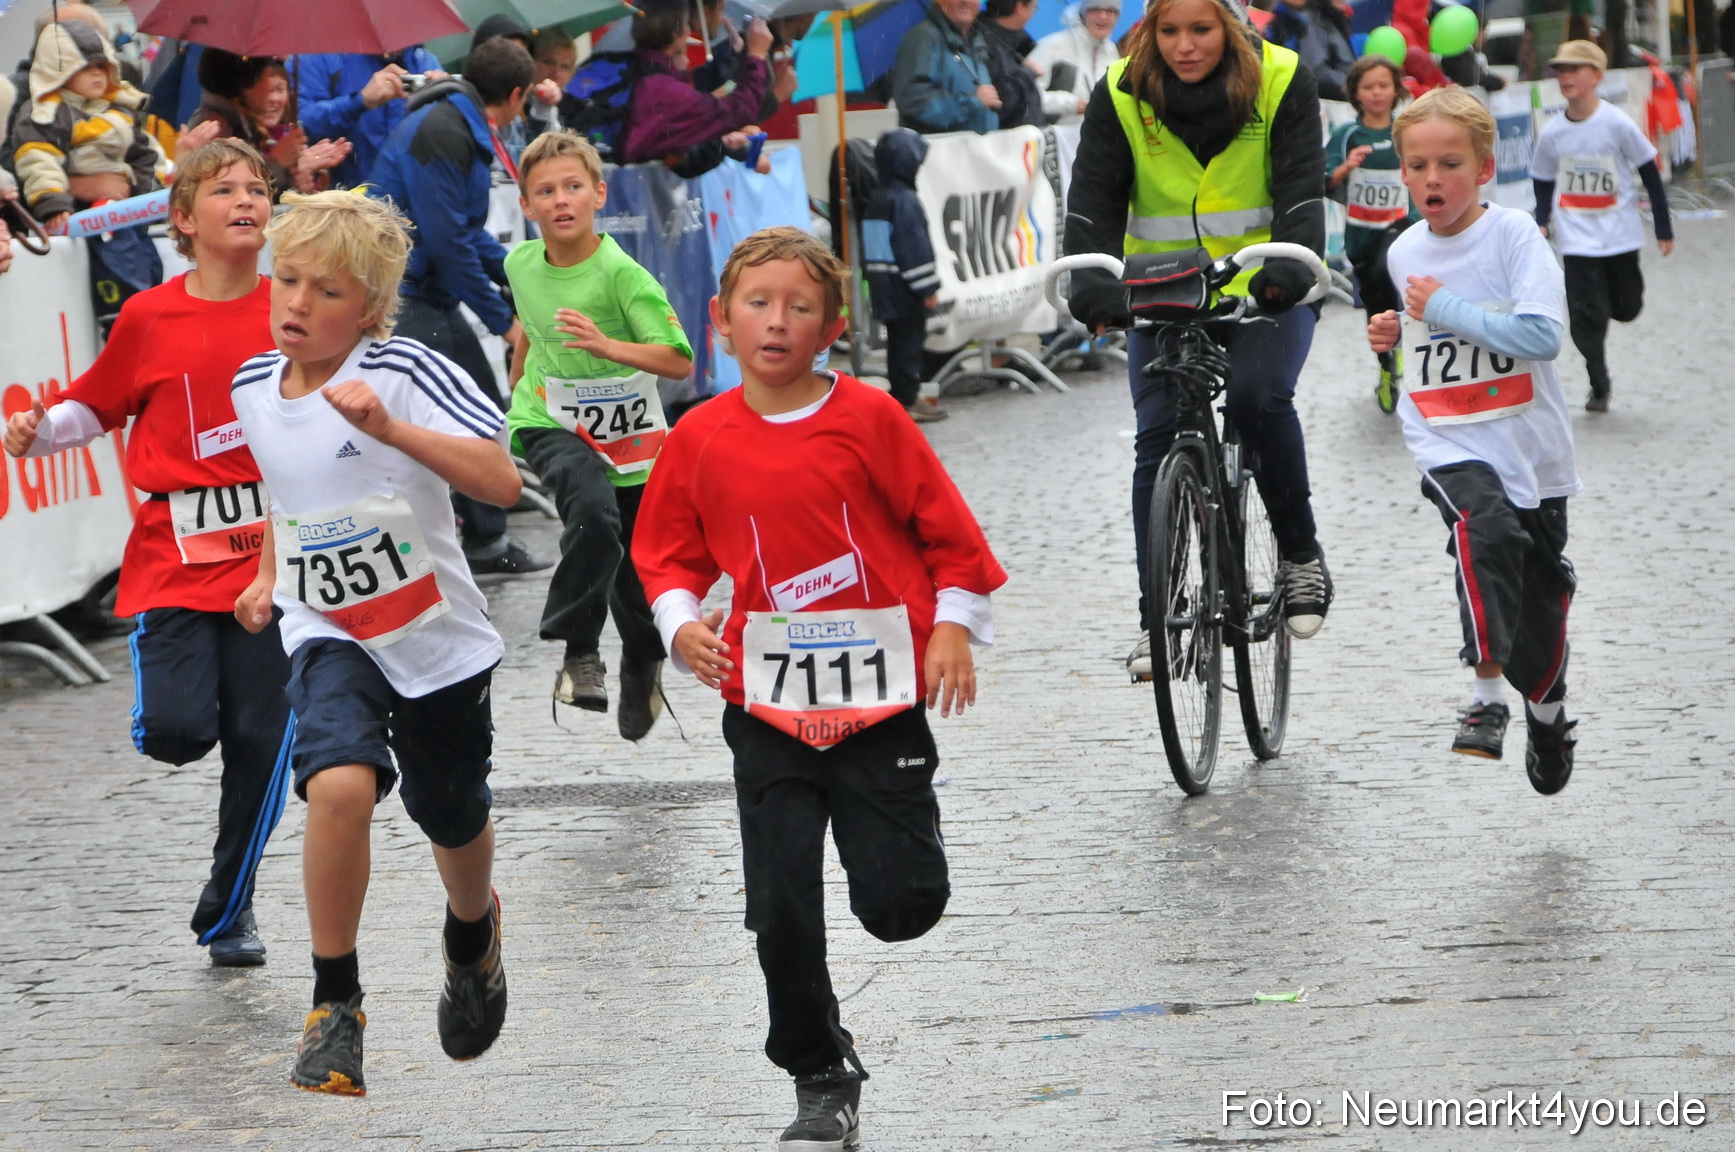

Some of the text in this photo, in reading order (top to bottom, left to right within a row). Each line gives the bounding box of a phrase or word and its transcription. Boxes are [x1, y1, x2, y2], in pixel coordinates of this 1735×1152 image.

[1566, 170, 1614, 193] 7176
[1353, 183, 1401, 207] 7097
[107, 200, 169, 225] ReiseCe
[576, 383, 626, 398] BOCK
[561, 397, 654, 440] 7242
[219, 427, 244, 445] DEH
[335, 450, 362, 459] adidas
[299, 515, 357, 542] BOCK
[228, 530, 265, 554] Nic
[286, 531, 409, 606] 7351
[795, 571, 833, 600] DEHN
[788, 620, 857, 640] BOCK
[763, 647, 888, 707] 7111
[793, 716, 867, 742] Tobias
[907, 757, 926, 767] JAKO
